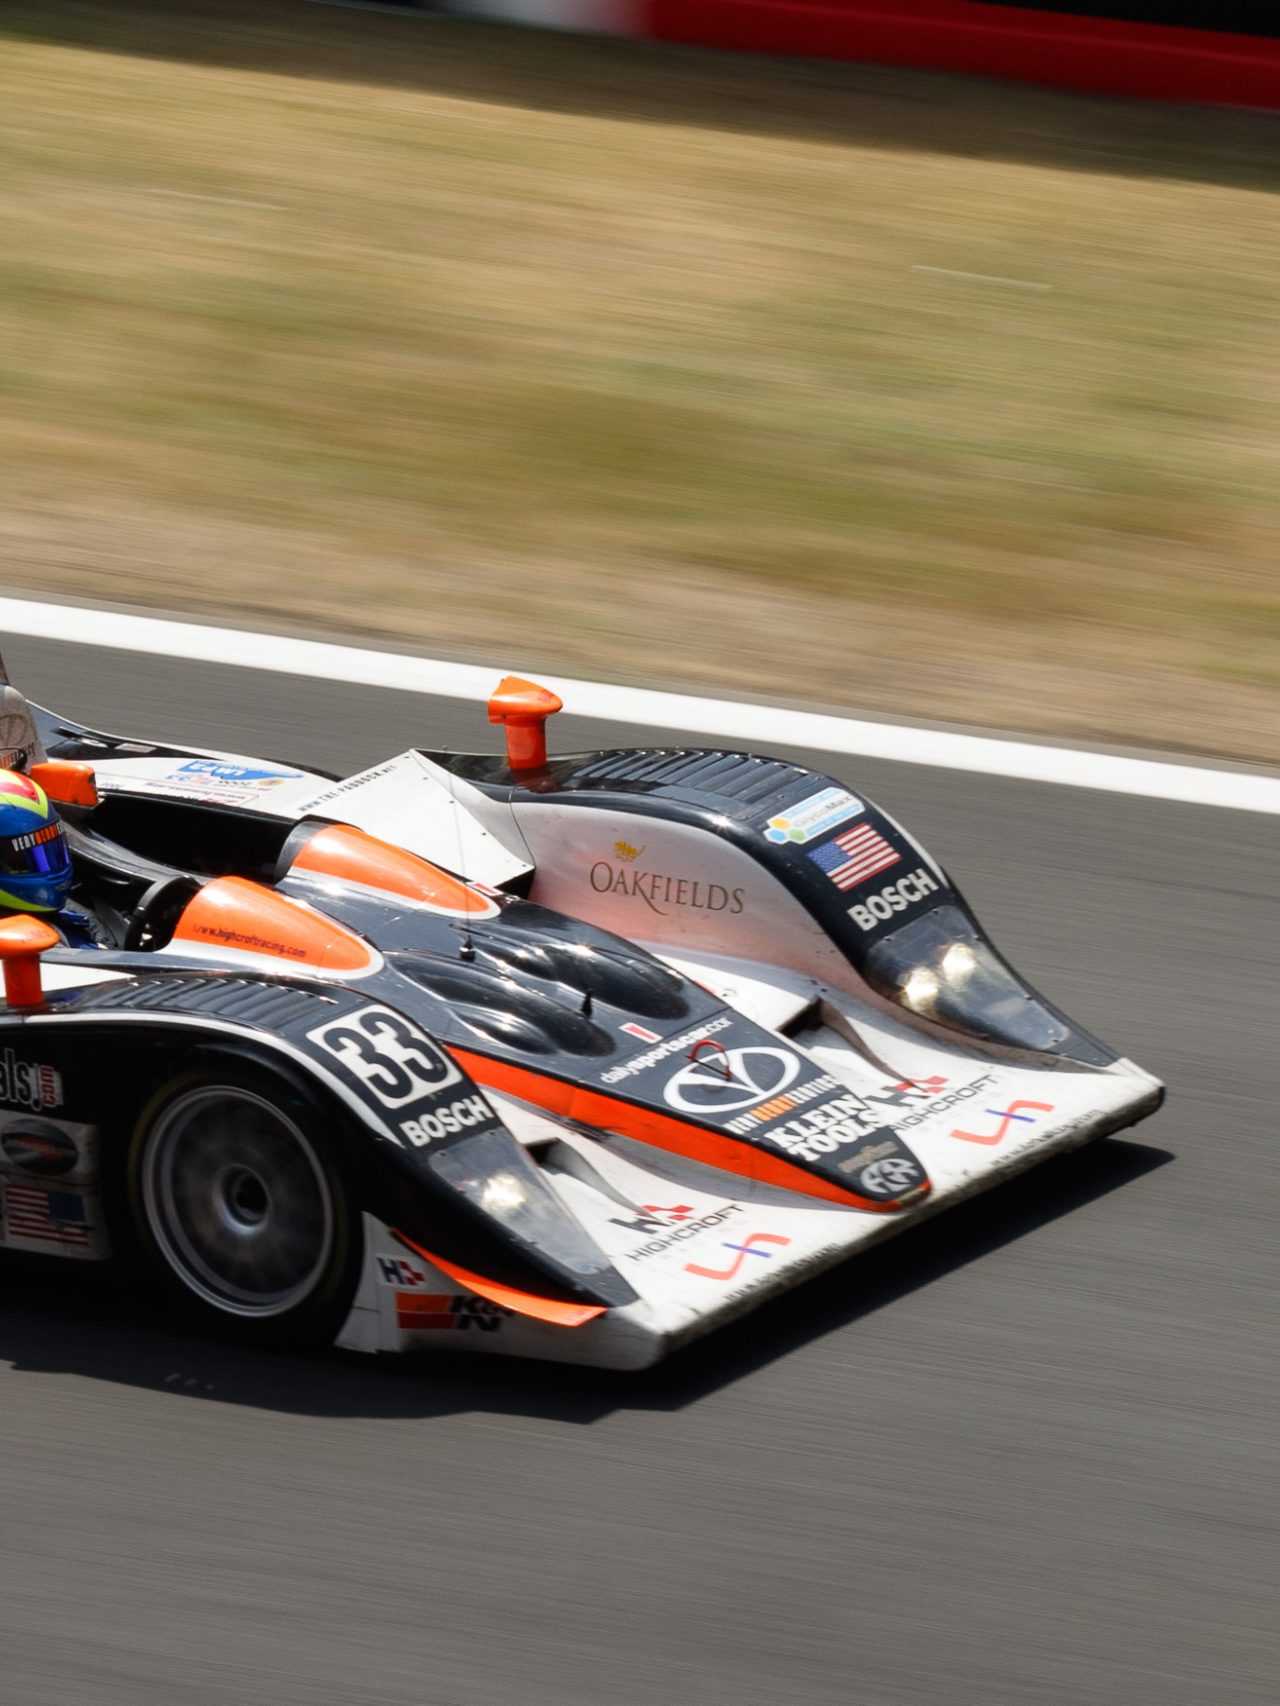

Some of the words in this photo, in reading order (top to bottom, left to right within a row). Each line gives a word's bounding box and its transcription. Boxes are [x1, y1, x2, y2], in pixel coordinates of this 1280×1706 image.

[590, 861, 746, 915] OAKFIELDS
[847, 868, 940, 932] BOSCH
[323, 1011, 449, 1099] 33
[399, 1095, 495, 1147] BOSCH
[764, 1094, 868, 1148] KLEIN
[786, 1109, 887, 1162] TOOLS
[624, 1203, 744, 1262] HIGHCROFT
